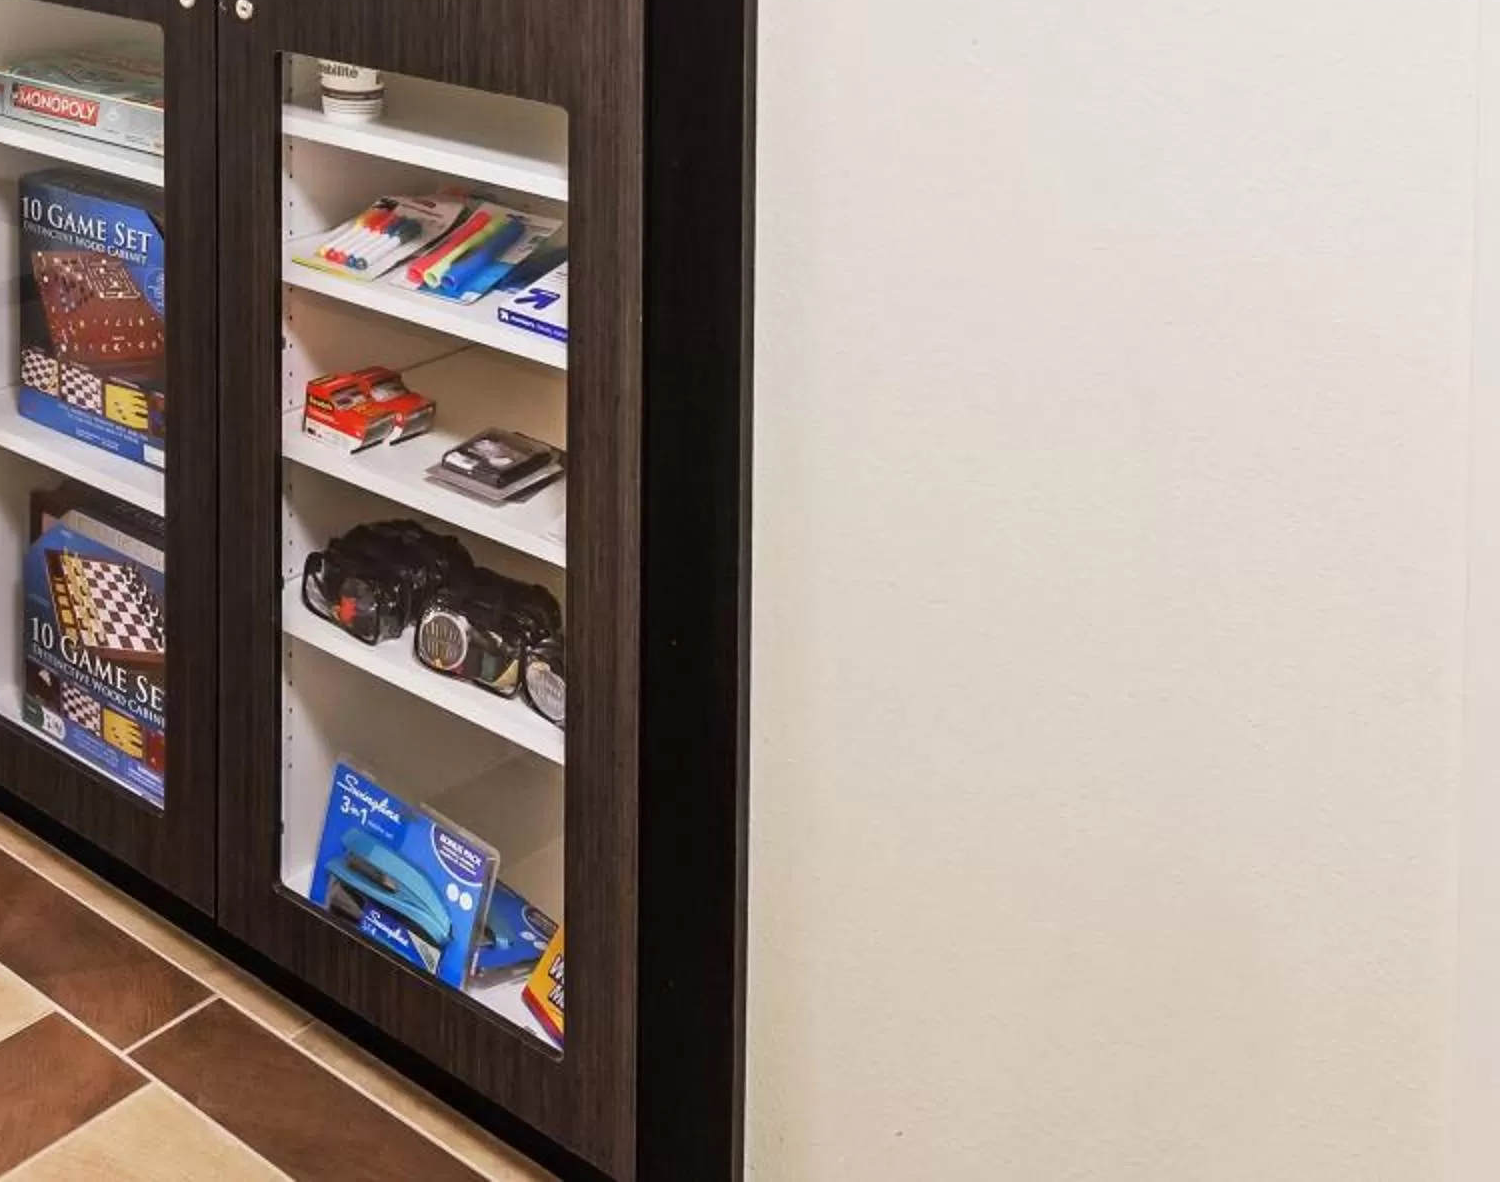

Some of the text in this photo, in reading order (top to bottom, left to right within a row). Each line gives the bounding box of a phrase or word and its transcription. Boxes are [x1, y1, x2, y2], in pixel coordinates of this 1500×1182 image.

[19, 88, 97, 120] MONOPOLY
[21, 196, 153, 253] 10 GAME SET
[31, 617, 54, 650] 10
[60, 636, 128, 693] GAME
